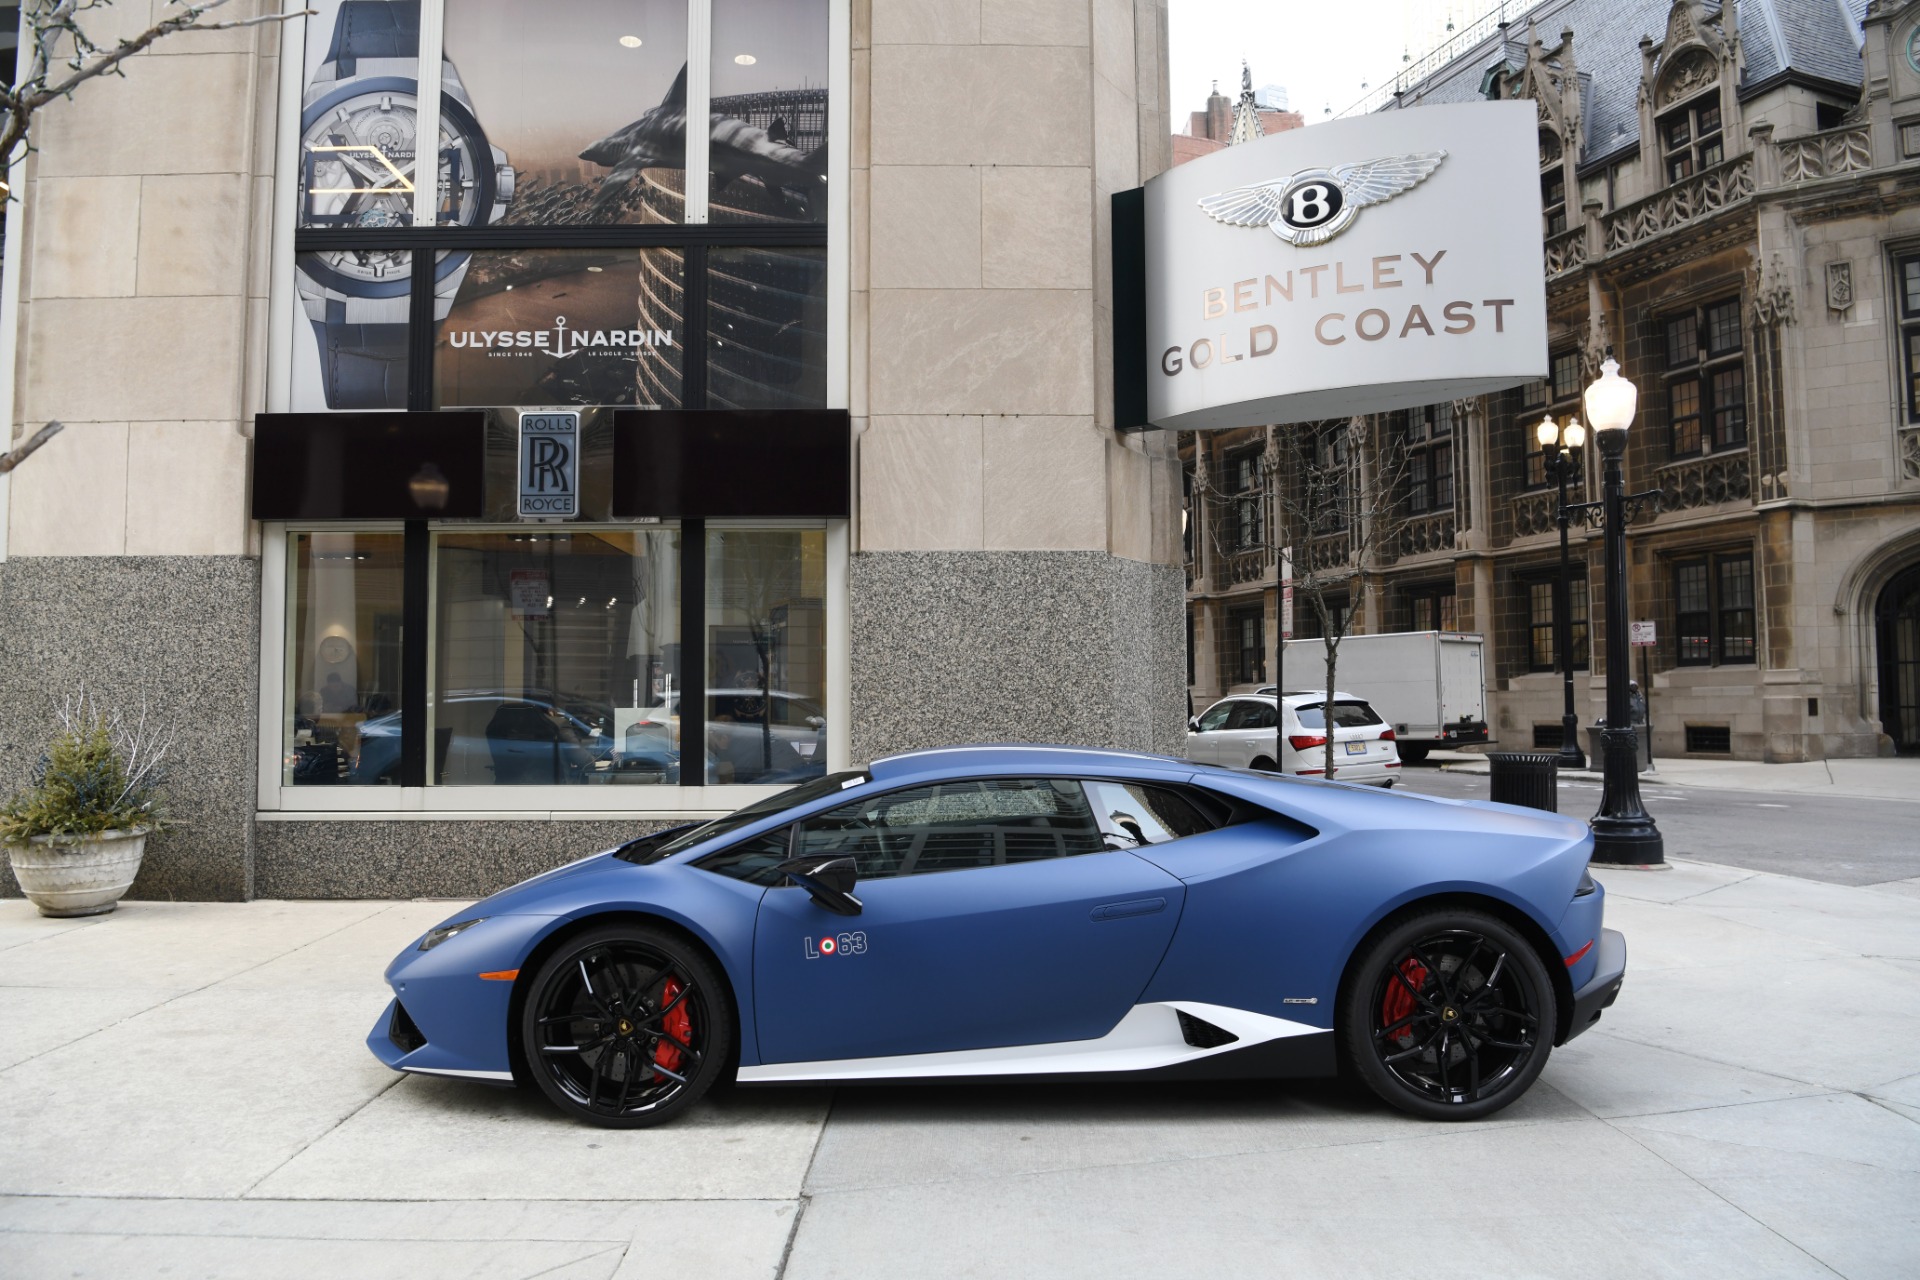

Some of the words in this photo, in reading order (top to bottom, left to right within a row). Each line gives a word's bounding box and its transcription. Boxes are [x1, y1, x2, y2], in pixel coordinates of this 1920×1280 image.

[1203, 250, 1447, 320] BENTLEY
[450, 332, 550, 348] ULYSSE
[571, 330, 672, 347] NARDIN
[1161, 324, 1279, 377] GOLD
[1314, 299, 1515, 346] COAST
[525, 418, 572, 430] ROLLS
[524, 499, 571, 510] ROYCE
